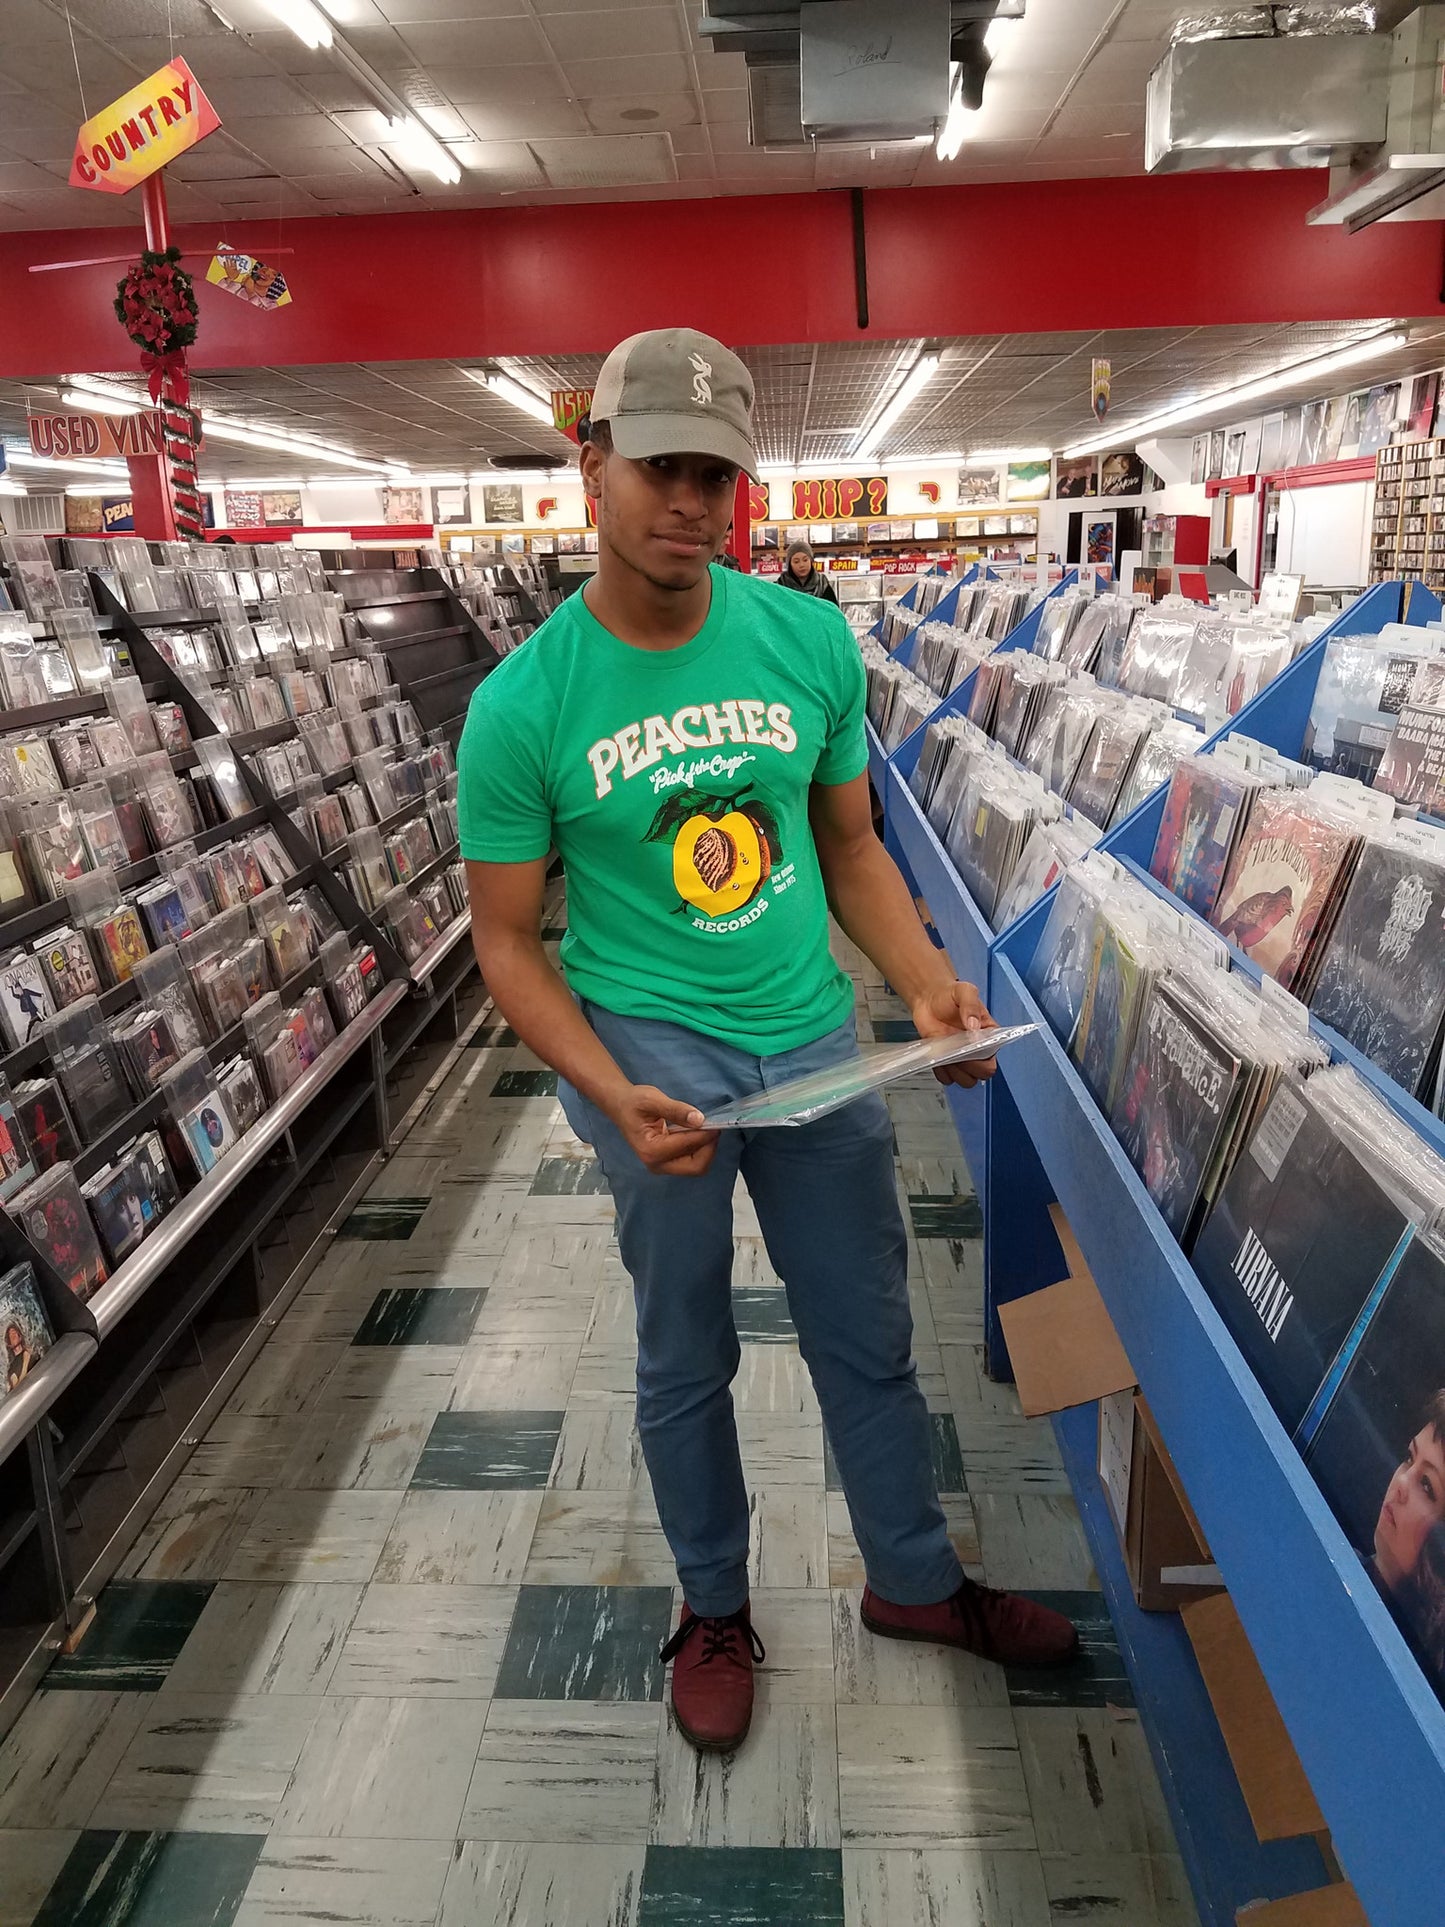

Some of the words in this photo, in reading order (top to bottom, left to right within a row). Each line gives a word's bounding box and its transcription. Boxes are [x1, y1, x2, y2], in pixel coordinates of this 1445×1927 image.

[76, 79, 195, 184] COUNTRY
[551, 391, 591, 430] USED
[31, 416, 99, 457] USED
[104, 413, 170, 455] VIN
[832, 560, 857, 570] SPAIN
[884, 563, 897, 573] POP
[898, 562, 916, 573] ROCK
[587, 700, 797, 800] PEACHES
[691, 898, 769, 933] RECORDS
[1230, 1226, 1295, 1344] NIRVANA
